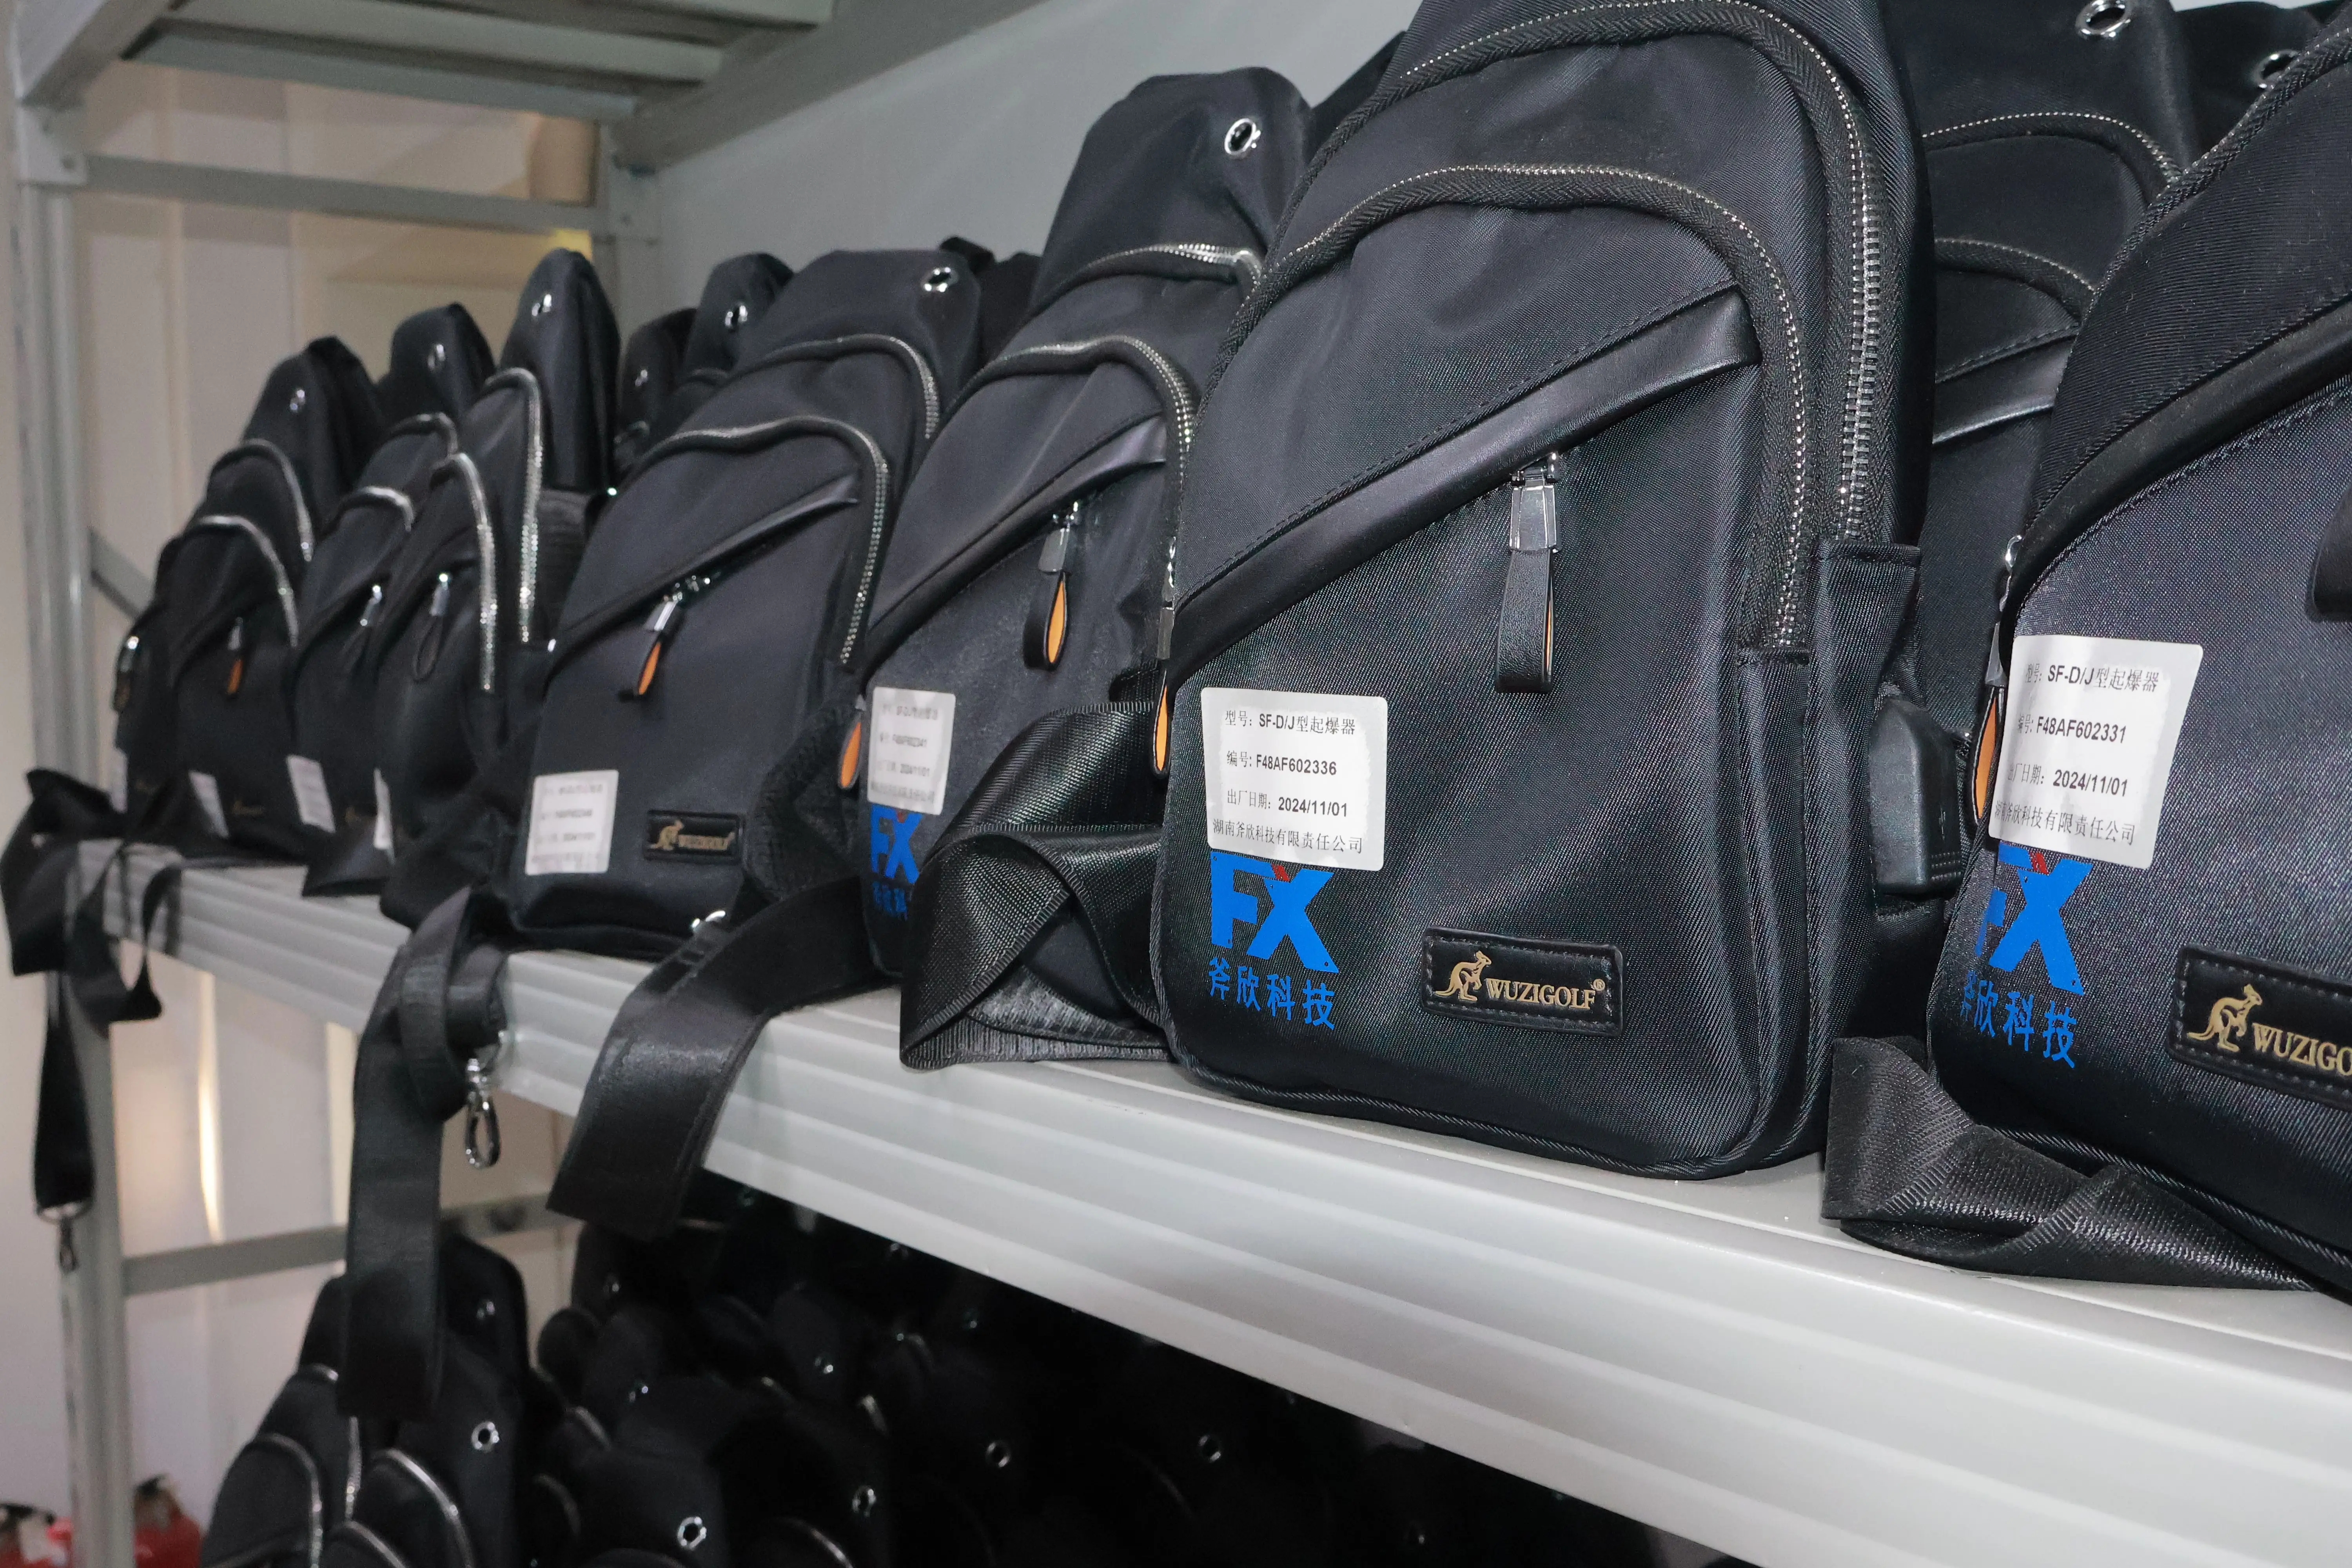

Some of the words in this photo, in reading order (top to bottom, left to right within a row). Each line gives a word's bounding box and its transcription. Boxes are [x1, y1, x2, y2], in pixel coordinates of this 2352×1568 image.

[2047, 665, 2160, 692] SF-D/J型起爆器
[1259, 713, 1355, 735] SF-D/J型起爆器
[2036, 716, 2127, 744] F48AF602331
[1256, 754, 1337, 775] F48AF602336
[2053, 769, 2128, 797] 2024/11/01
[1278, 797, 1347, 817] 2024/11/01
[1213, 818, 1363, 854] 湖南斧欣科技有限责任公司
[1210, 851, 1339, 973] FX
[1209, 957, 1335, 1030] 斧欣科技
[1486, 978, 1595, 1009] WUZIGOLF
